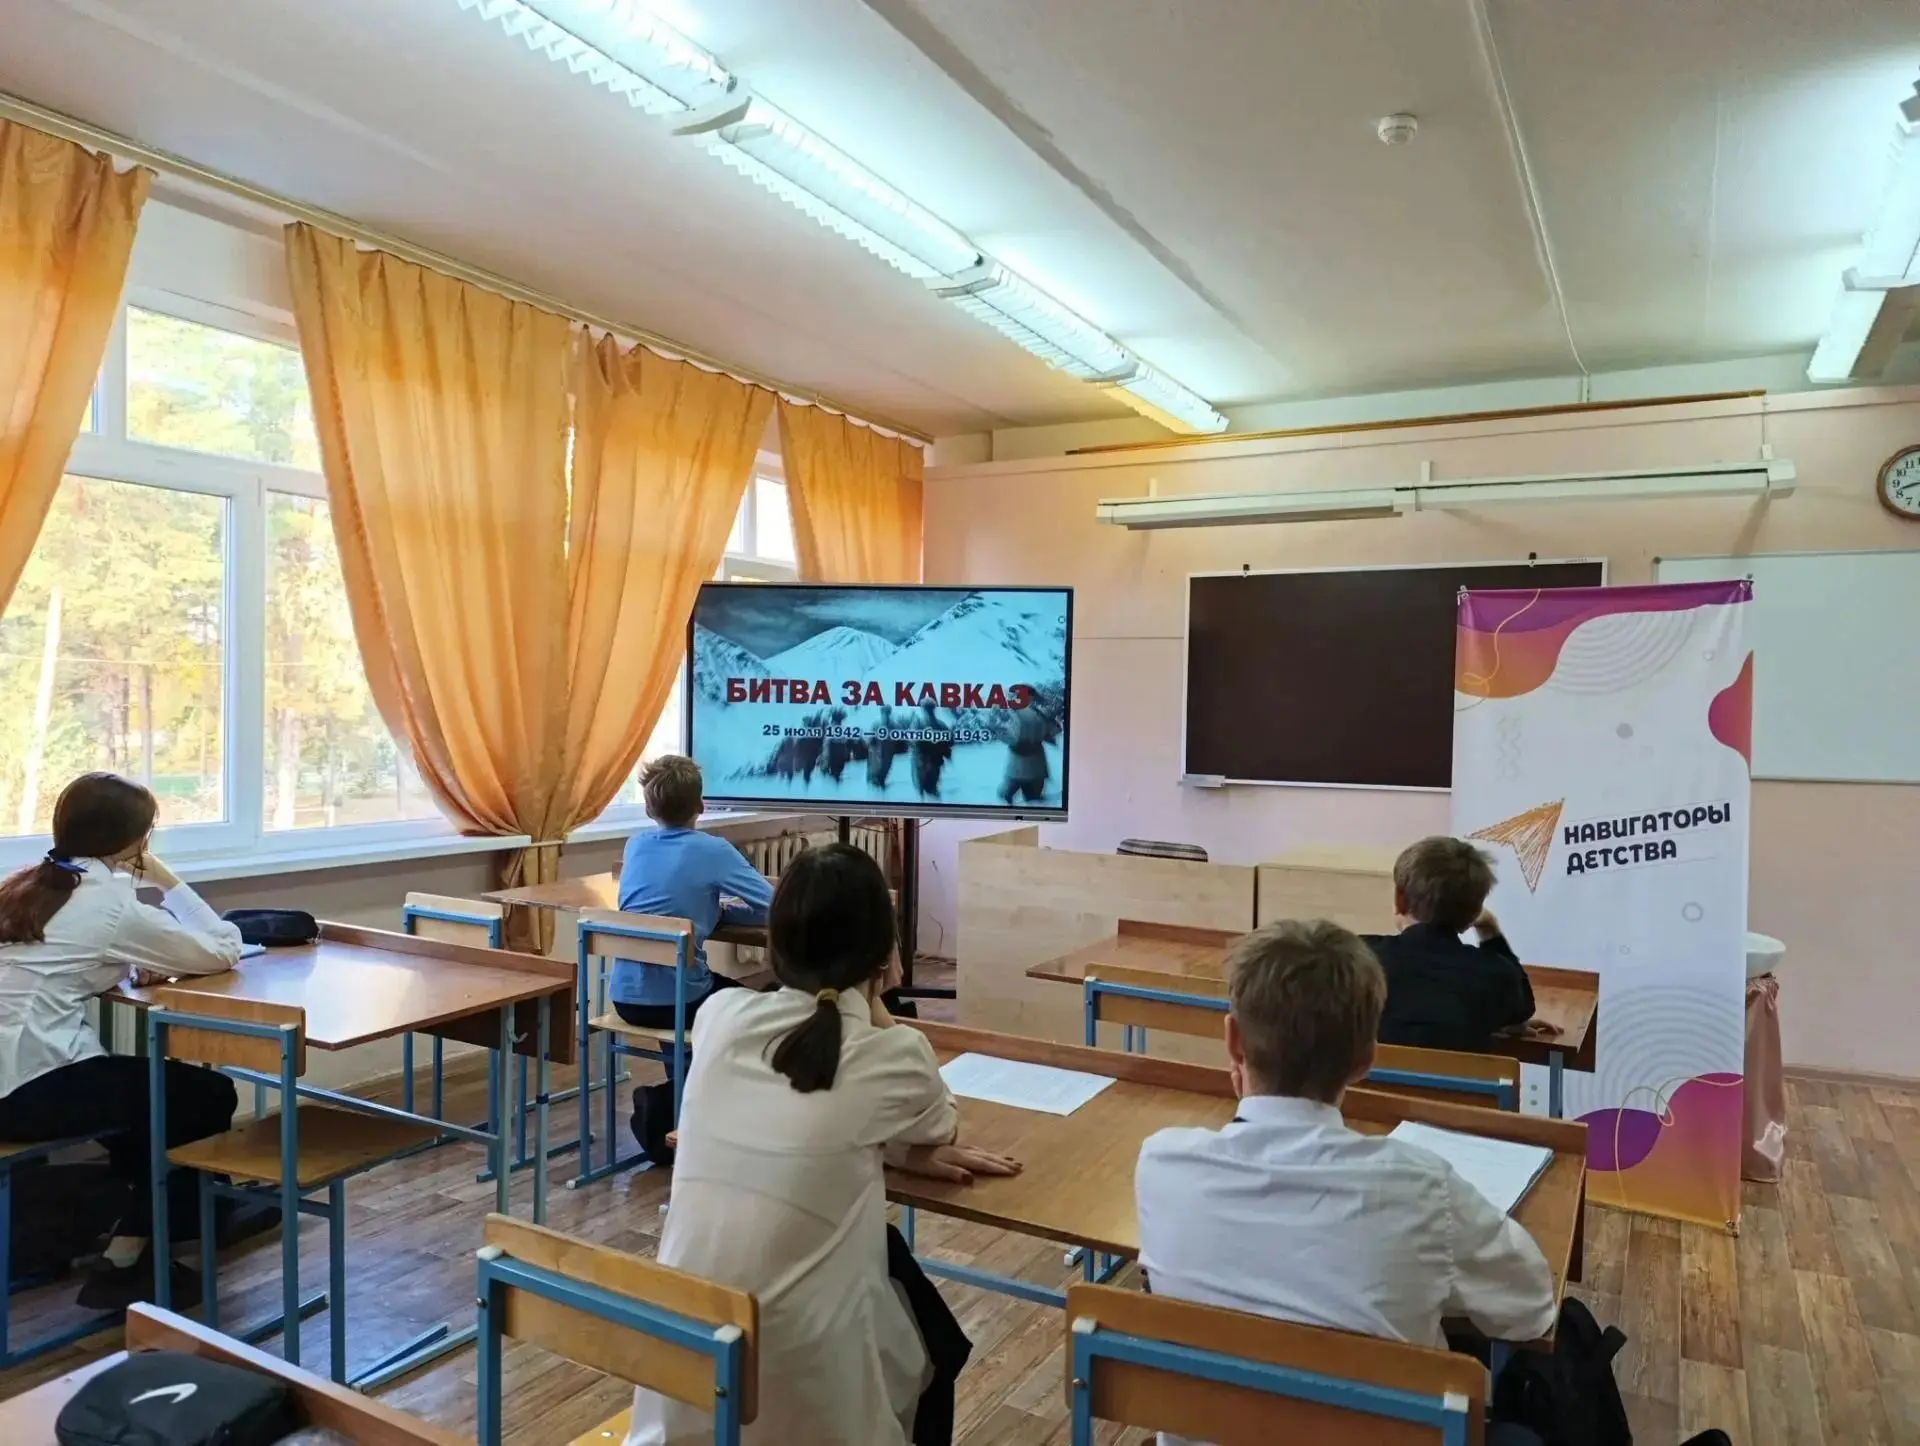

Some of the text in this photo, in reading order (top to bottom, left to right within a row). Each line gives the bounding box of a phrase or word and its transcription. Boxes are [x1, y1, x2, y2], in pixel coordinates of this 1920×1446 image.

[727, 678, 1030, 710] БИТВА ЗА КАВКАЗ
[762, 724, 780, 736] 25
[784, 727, 821, 737] июля
[826, 726, 860, 738] 1942
[878, 728, 888, 739] 9
[890, 728, 950, 743] октября
[954, 730, 990, 741] 1943
[1564, 802, 1731, 845] НАВИГАТОРЫ
[1566, 839, 1677, 875] ДЕТСТВА
